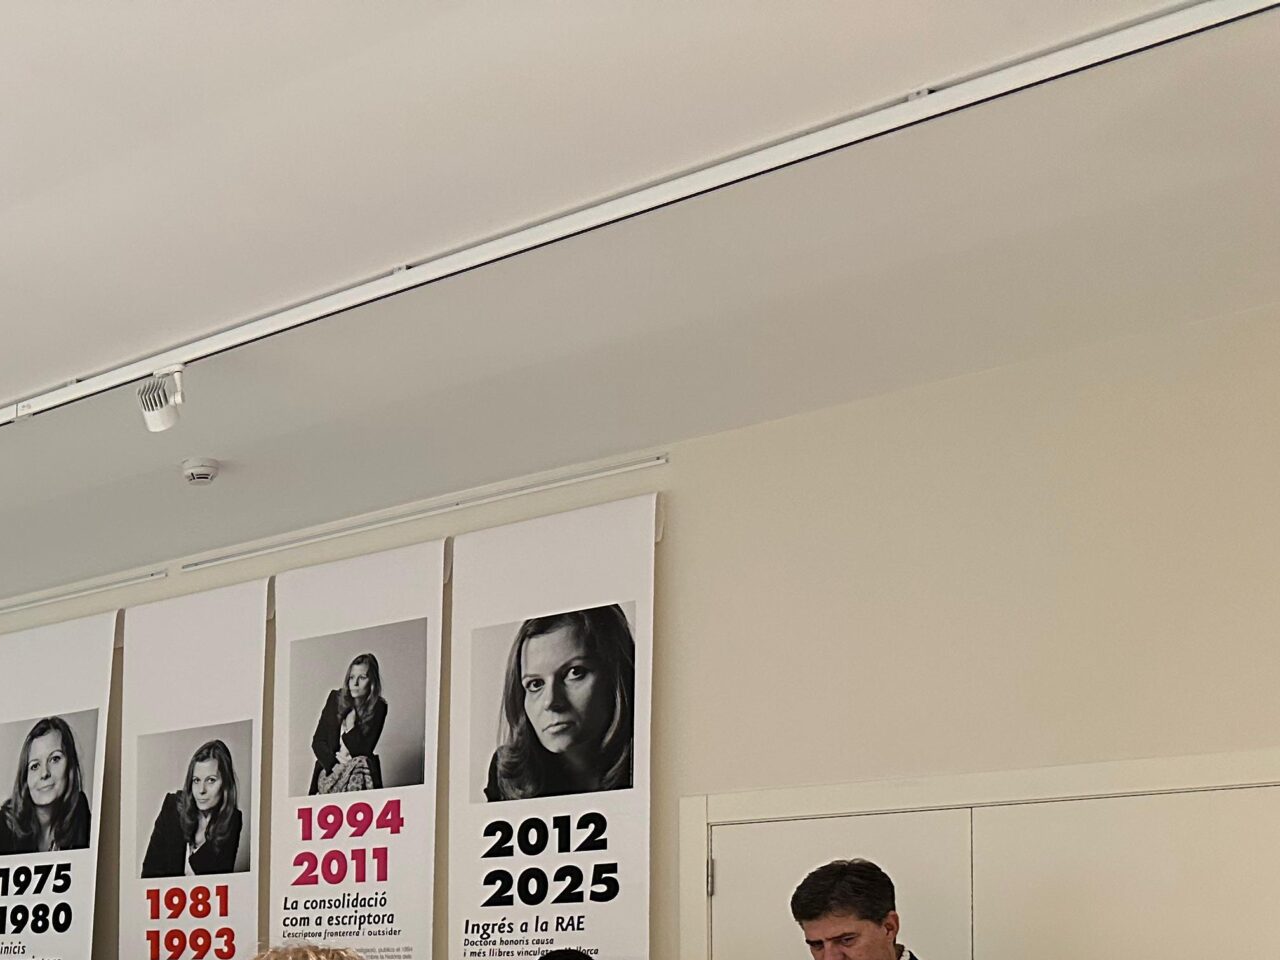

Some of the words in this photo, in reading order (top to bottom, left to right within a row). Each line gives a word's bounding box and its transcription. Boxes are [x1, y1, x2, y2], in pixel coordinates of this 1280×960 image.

[297, 798, 405, 842] 1994
[481, 812, 608, 859] 2012
[0, 863, 71, 896] 1975
[291, 847, 388, 886] 2011
[480, 862, 620, 907] 2025
[146, 884, 229, 920] 1981
[283, 896, 298, 911] La
[303, 891, 387, 910] consolidació
[282, 916, 310, 927] com
[315, 915, 322, 926] a
[327, 909, 395, 931] escriptora
[282, 929, 322, 940] L'escriptora
[323, 928, 360, 941] fronterera
[367, 927, 402, 937] outsider
[464, 917, 514, 940] Ingrés
[520, 921, 528, 933] a
[535, 915, 549, 932] la
[555, 915, 585, 932] RAE
[0, 941, 26, 955] inicis
[146, 926, 236, 960] 1993
[463, 938, 496, 947] Doctora
[499, 937, 529, 946] honoris
[470, 948, 486, 957] més
[488, 948, 514, 957] llibres
